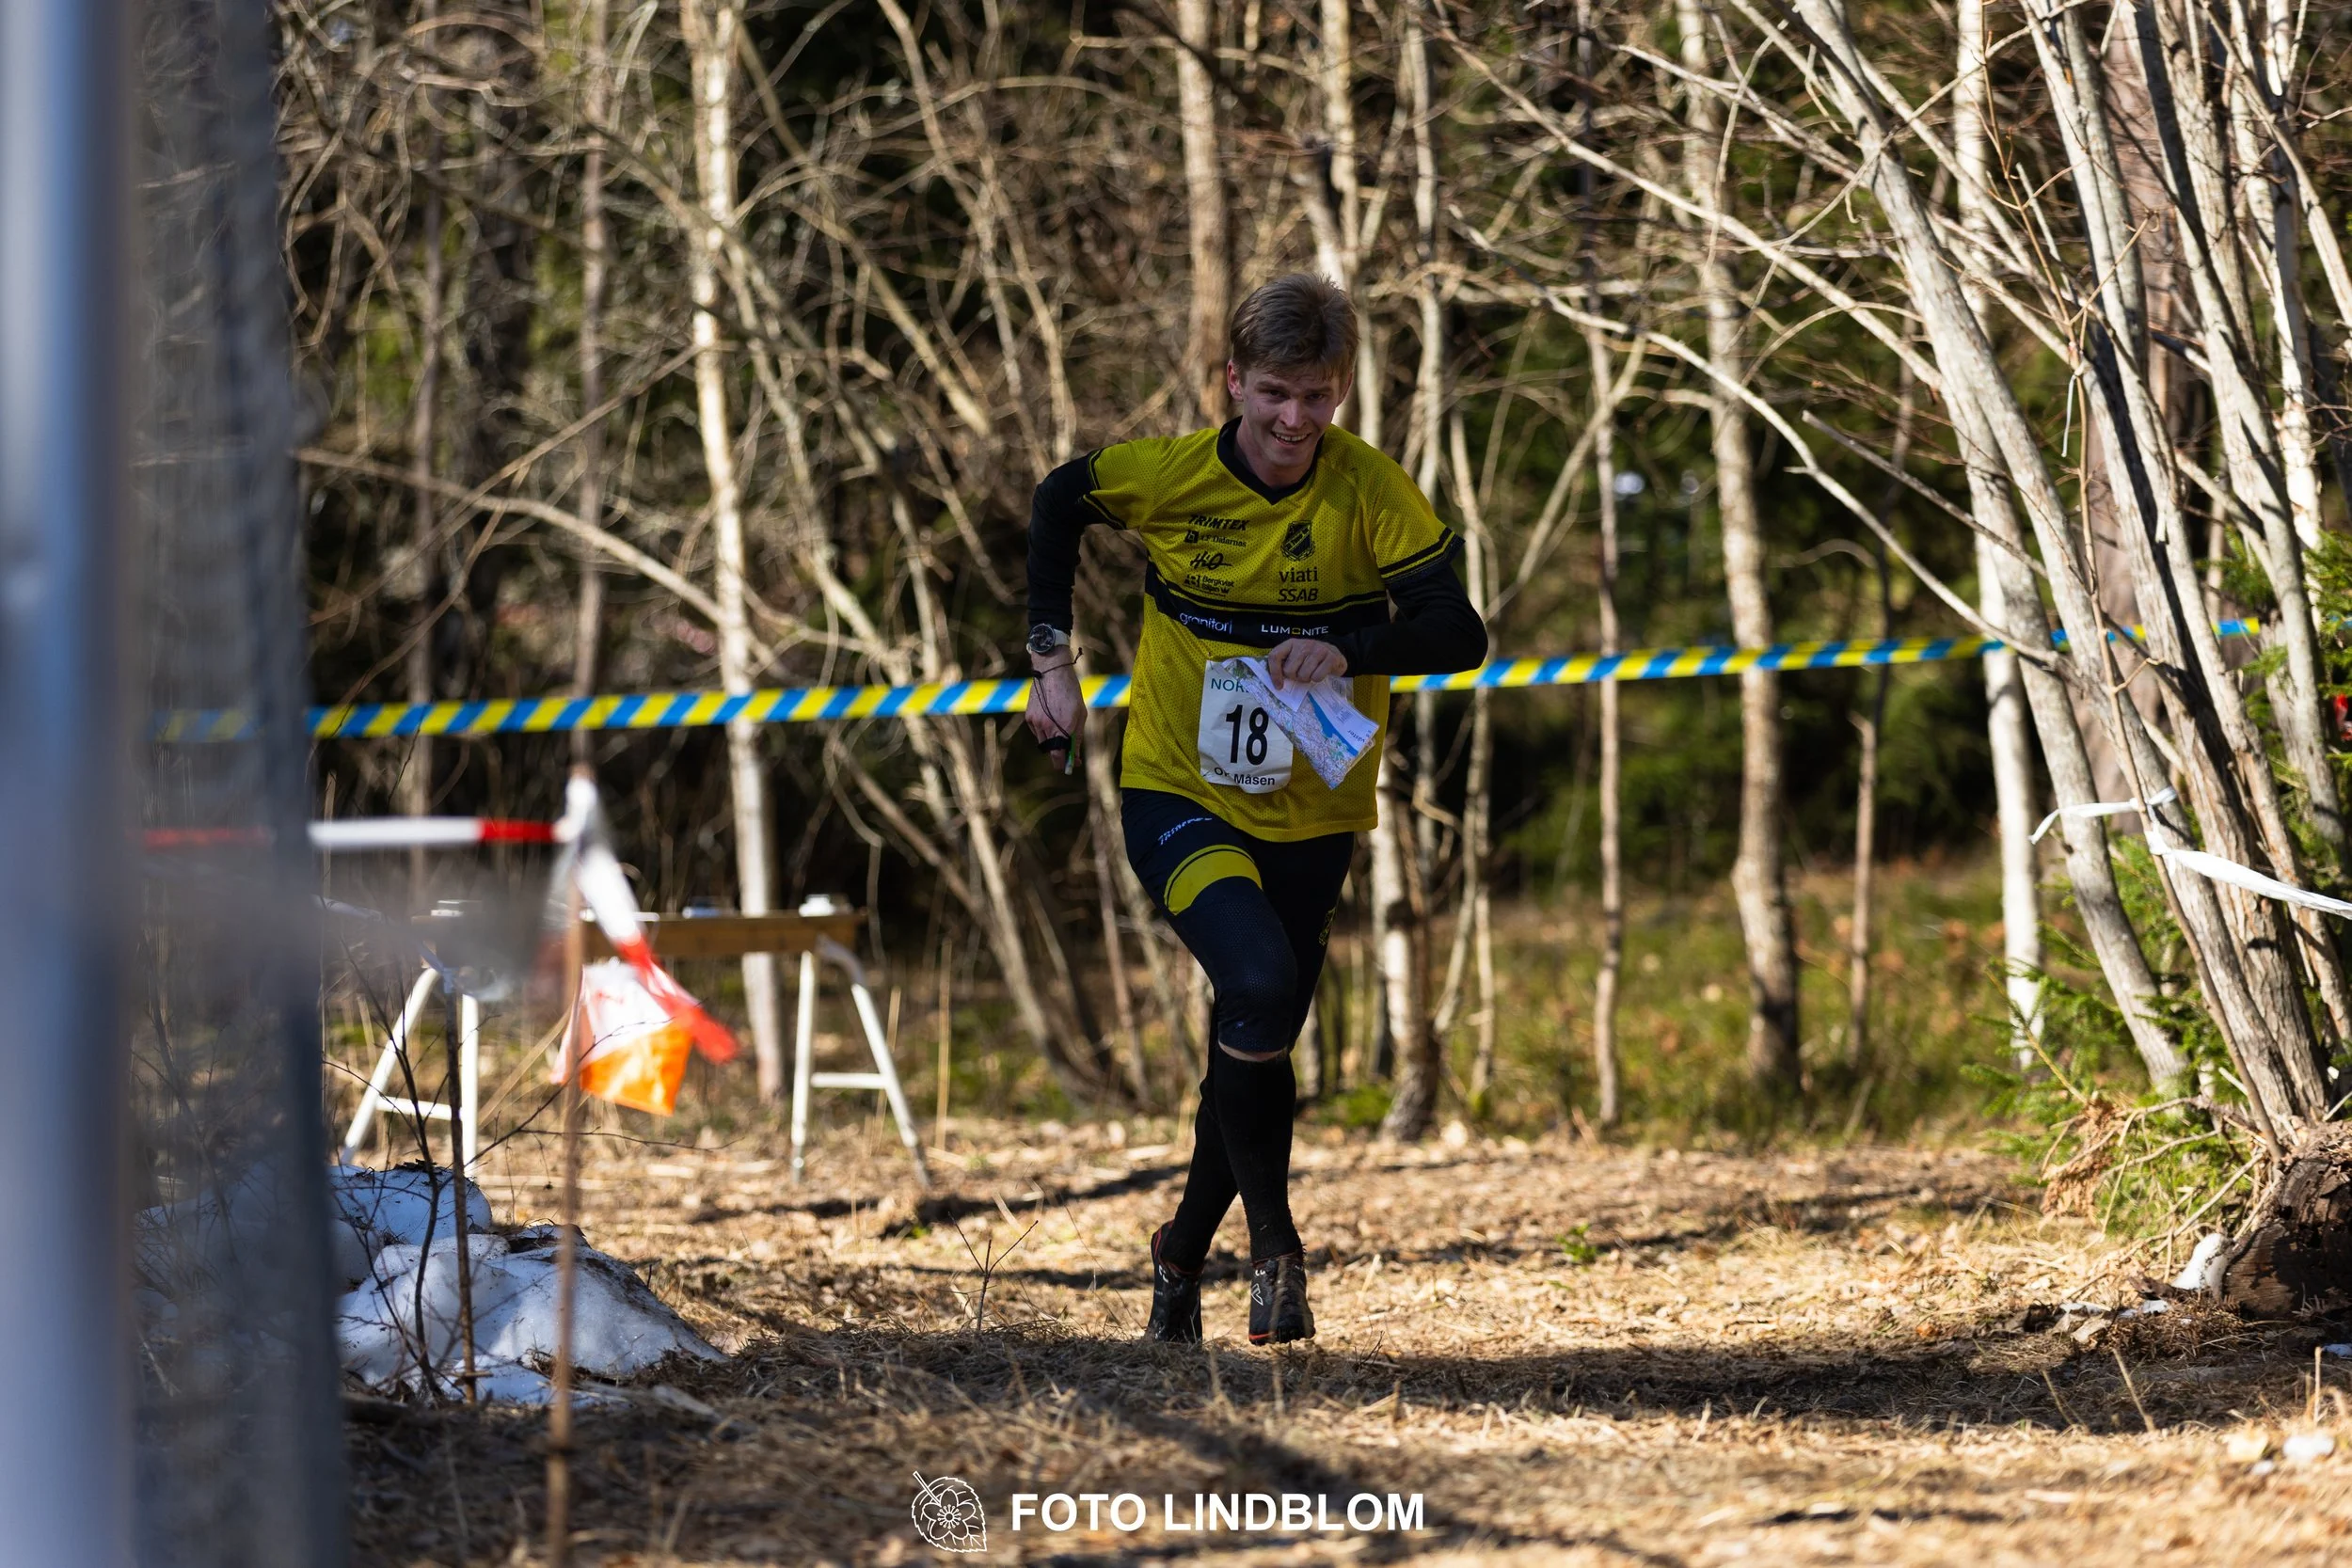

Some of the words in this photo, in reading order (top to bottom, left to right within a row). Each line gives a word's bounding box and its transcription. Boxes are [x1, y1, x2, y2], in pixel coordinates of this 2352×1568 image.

[1279, 566, 1318, 583] viati
[1278, 588, 1318, 602] SSAB
[1226, 704, 1269, 766] 18
[1234, 773, 1275, 785] Måsen
